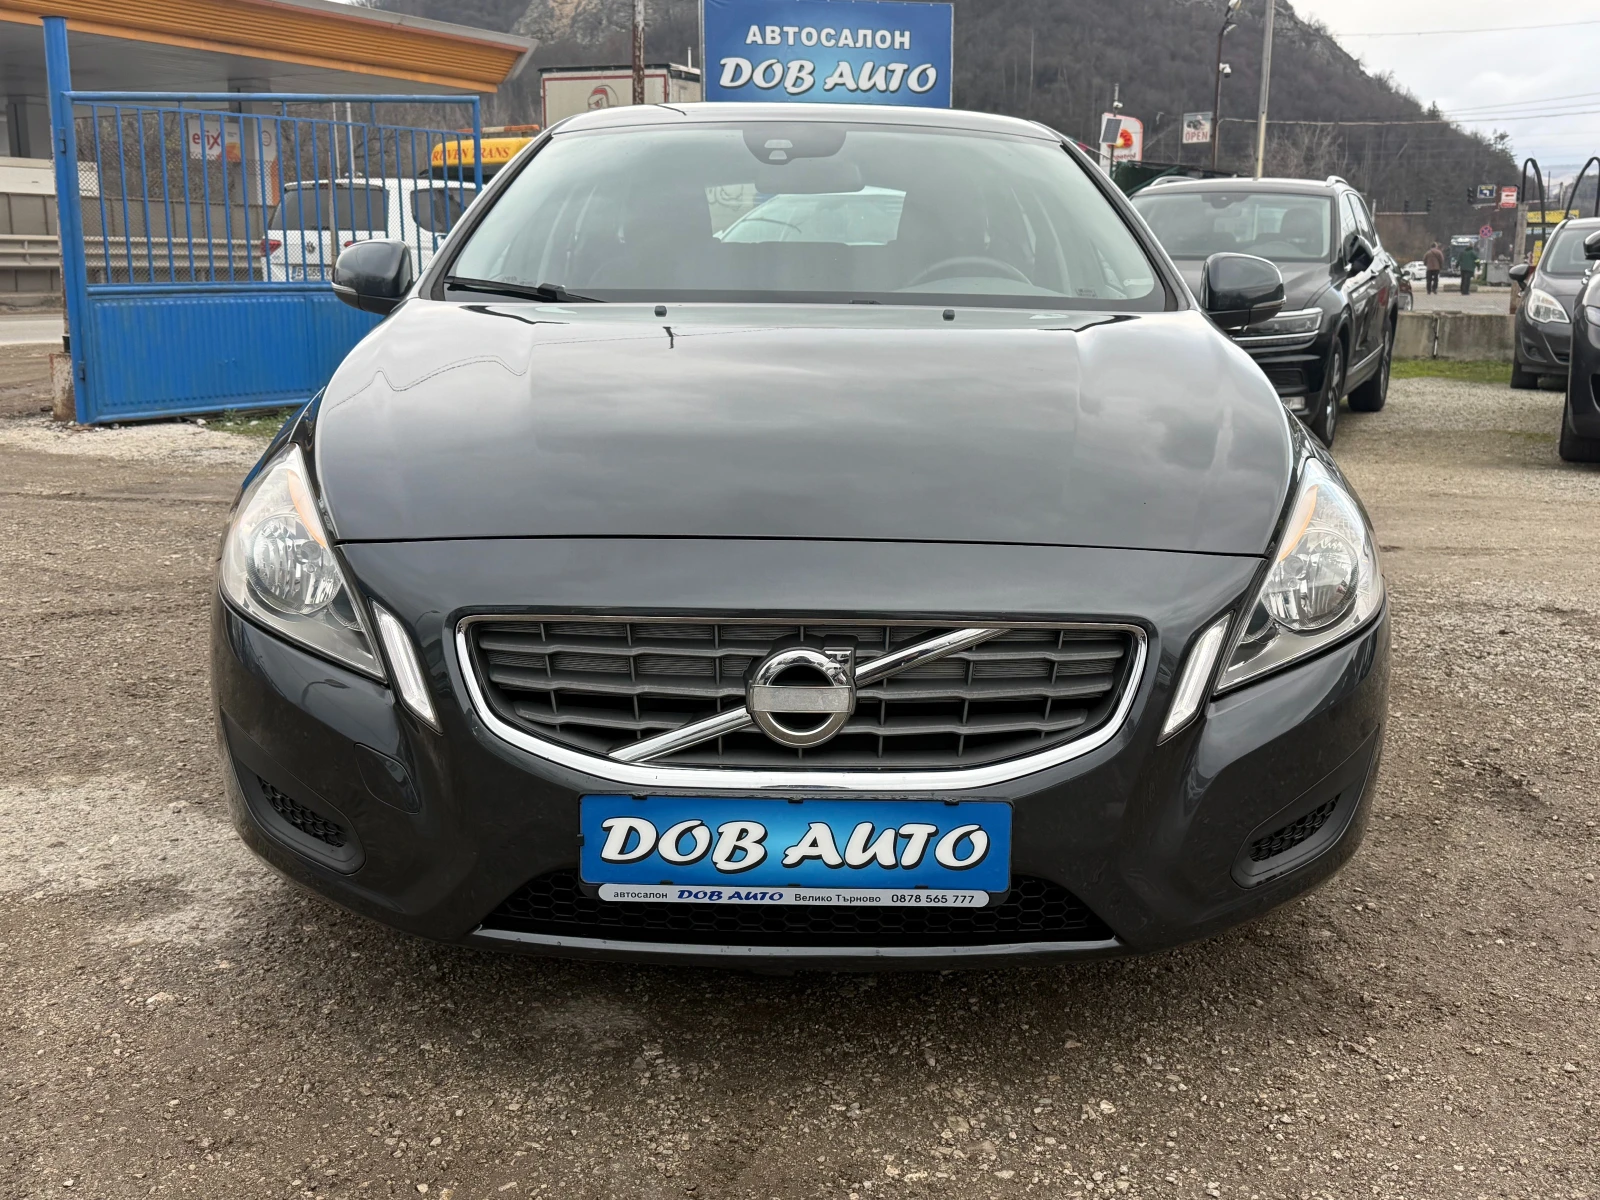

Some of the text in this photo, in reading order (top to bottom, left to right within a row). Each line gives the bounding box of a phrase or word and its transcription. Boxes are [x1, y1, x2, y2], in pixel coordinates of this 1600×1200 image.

[745, 25, 911, 49] АВТОСАЛОН
[719, 57, 937, 94] DOB AUTO
[1185, 131, 1208, 141] OPEN
[601, 816, 990, 874] DOB AUTO
[613, 889, 975, 904] автосалон DOB AUTO Велико Търново 0878 565 777
